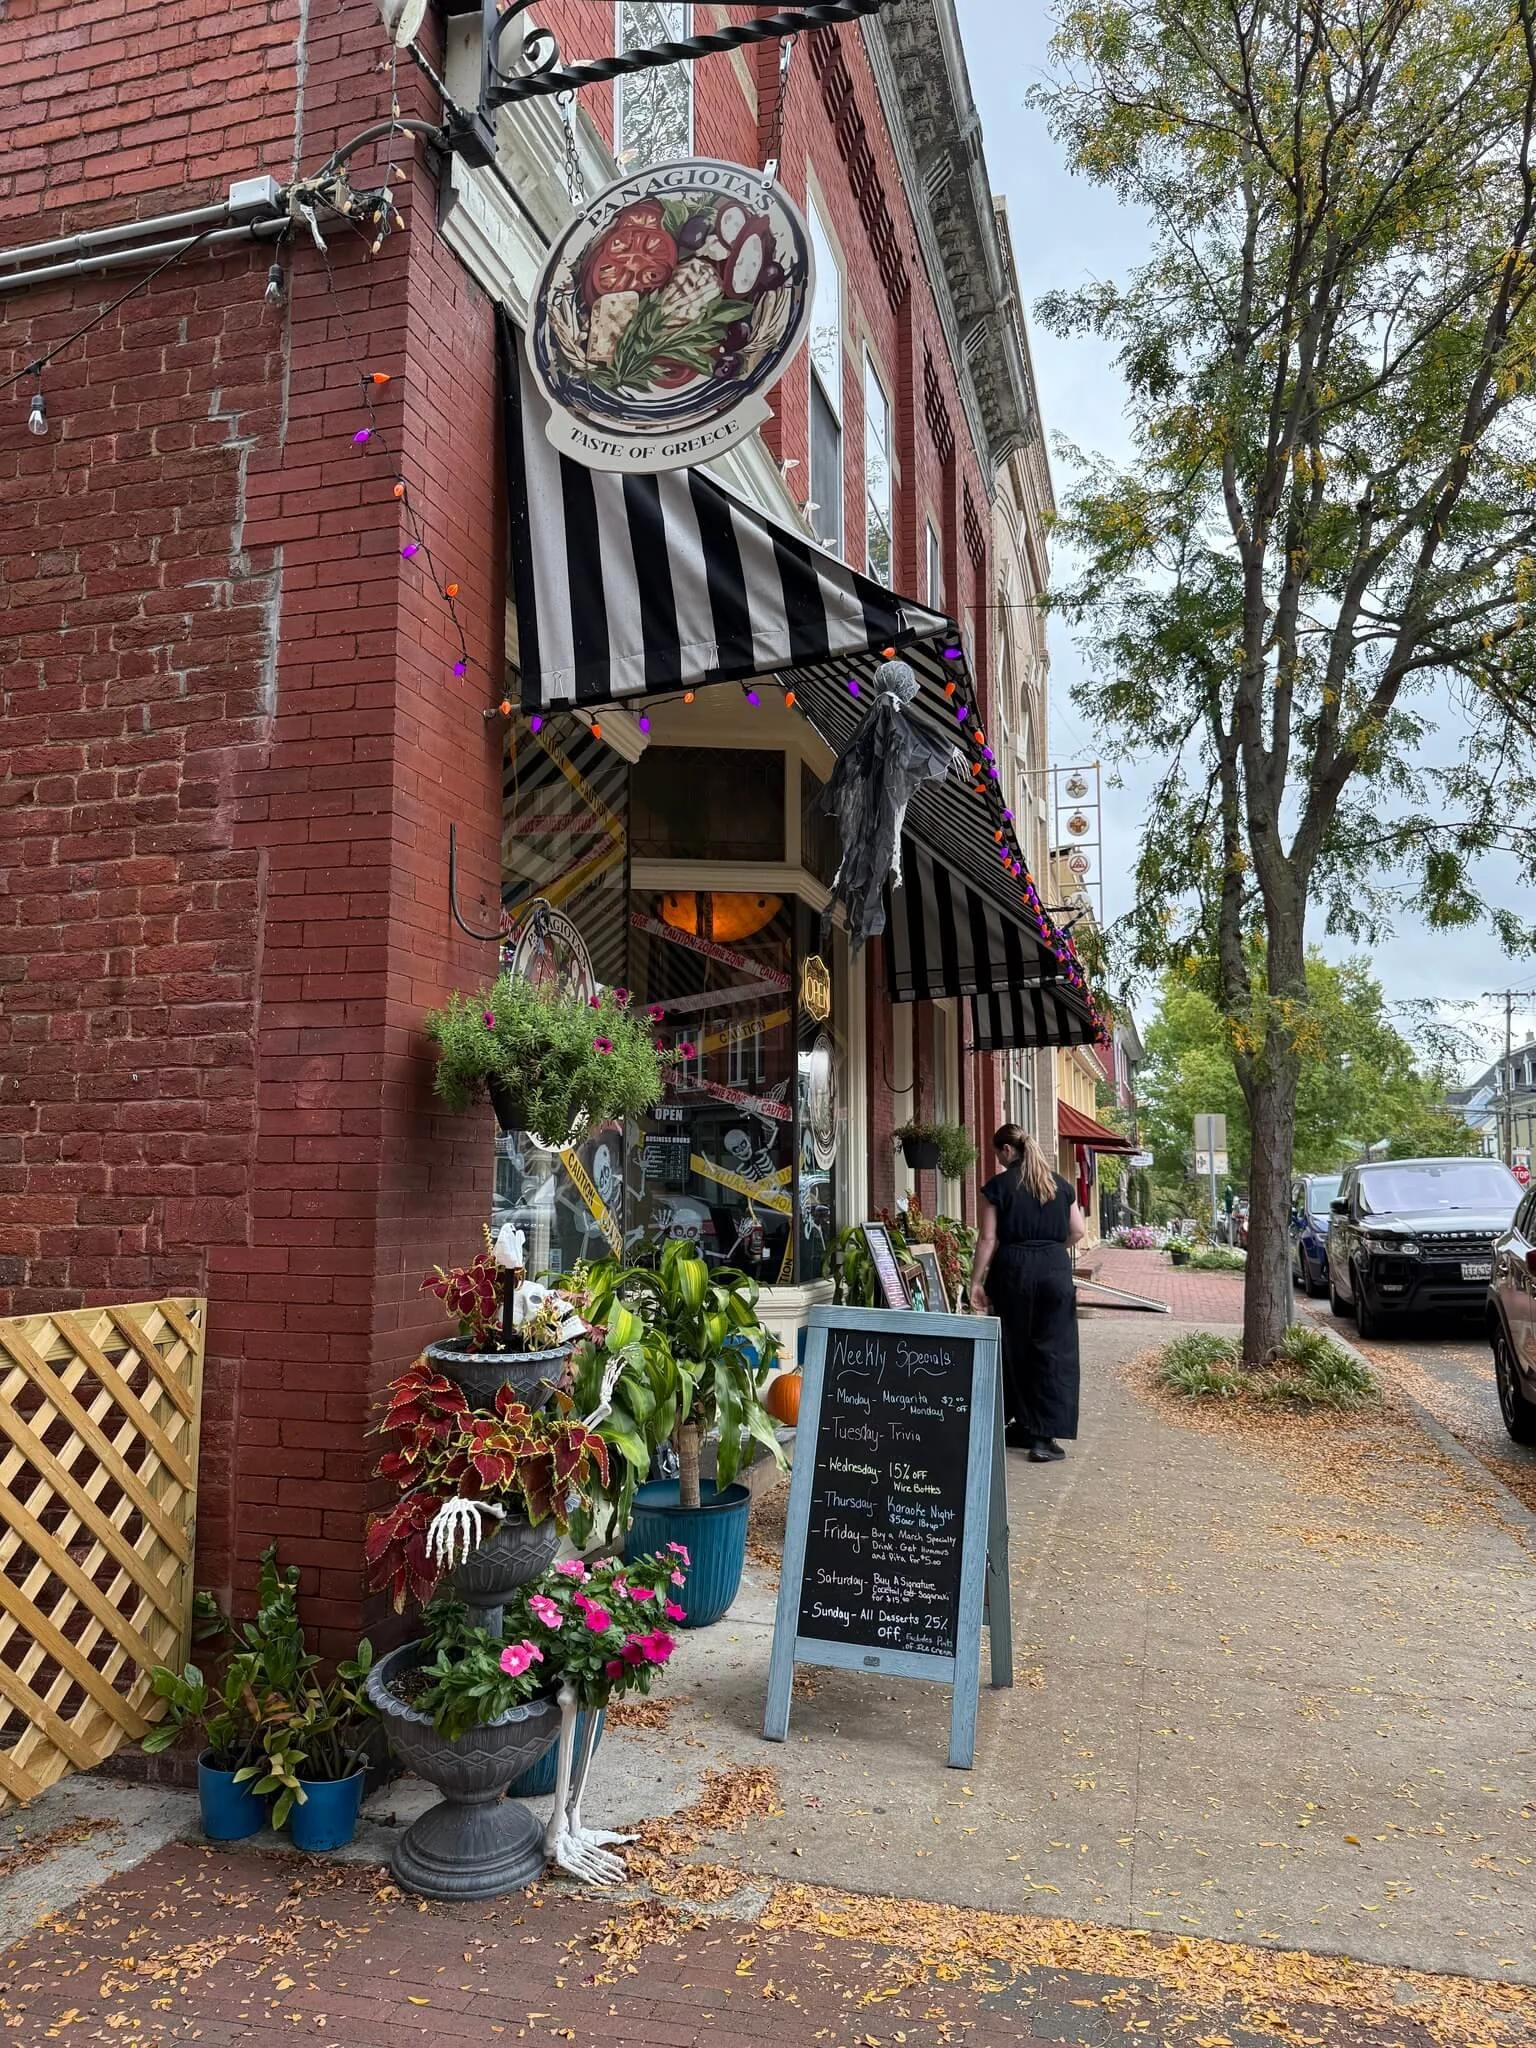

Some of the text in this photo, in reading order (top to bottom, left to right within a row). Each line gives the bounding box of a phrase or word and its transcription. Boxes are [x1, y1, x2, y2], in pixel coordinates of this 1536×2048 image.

[585, 168, 775, 230] PANAGIOTA'S
[570, 420, 739, 460] TASTE OF GREECE
[806, 976, 830, 1009] OPEN
[719, 1020, 766, 1044] CAUTION
[655, 1108, 683, 1121] OPEN
[568, 1153, 595, 1206] CAUTION
[832, 1333, 887, 1385] Weekly
[883, 1390, 928, 1411] Margarita
[910, 1406, 945, 1422] Monday
[888, 1422, 921, 1442] Trivia
[889, 1461, 911, 1480] 15%
[913, 1483, 941, 1495] Bottles
[887, 1494, 926, 1517] Karaoke
[930, 1504, 956, 1527] Night
[871, 1527, 886, 1542] Buy
[899, 1529, 924, 1542] March
[926, 1533, 957, 1548] Specialty
[871, 1552, 886, 1561] and
[888, 1552, 906, 1563] Pita
[899, 1542, 917, 1552] Get
[920, 1545, 949, 1556] Hummus
[873, 1572, 890, 1587] Buy
[893, 1575, 900, 1586] A
[900, 1576, 936, 1592] Signature
[860, 1608, 873, 1621] All
[878, 1609, 920, 1626] Desserts
[924, 1614, 949, 1631] 25%
